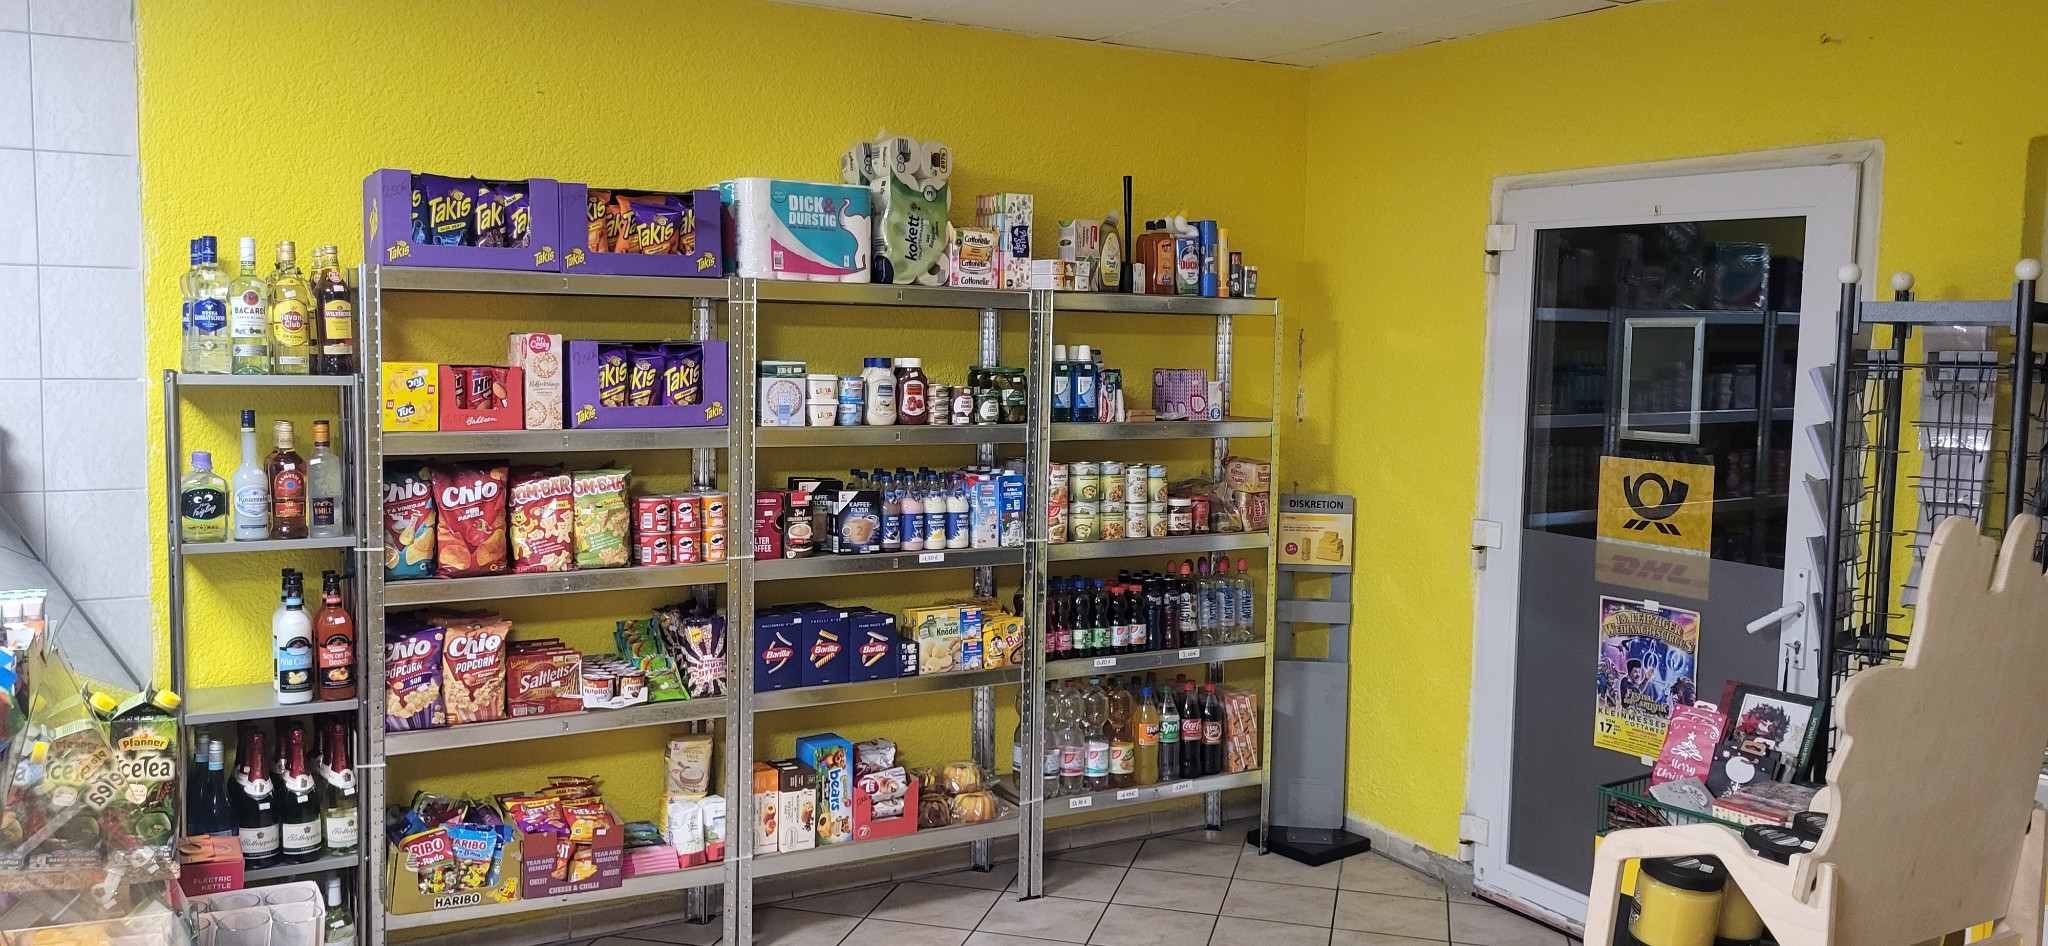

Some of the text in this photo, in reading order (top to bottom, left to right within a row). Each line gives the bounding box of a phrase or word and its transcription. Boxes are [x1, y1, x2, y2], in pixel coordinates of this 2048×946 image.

[429, 197, 472, 231] Takis
[788, 211, 837, 228] DURSTIG
[636, 221, 674, 250] Takis
[905, 214, 920, 261] kokett
[284, 319, 301, 328] Club
[599, 362, 627, 389] akis
[664, 364, 700, 397] Takis
[397, 406, 415, 416] TUC
[442, 480, 498, 507] Chio
[1290, 500, 1344, 509] DISKRETION
[1611, 554, 1692, 585] DHL
[936, 627, 958, 636] Knödel
[1632, 613, 1684, 636] LEIPZIGER
[449, 632, 501, 657] Chio
[1603, 624, 1695, 653] WEIHNACHTSCIRCUS
[815, 645, 838, 654] Barilla
[863, 645, 886, 653] Barilla
[328, 657, 349, 666] Beach
[455, 655, 494, 674] POPCORN
[519, 663, 570, 693] Saltletts
[1598, 708, 1667, 728] KLEINMESSEP
[1625, 720, 1665, 735] COTTAWEG
[1671, 759, 1696, 777] Merry
[830, 769, 842, 811] bears
[406, 838, 444, 856] RIBO
[528, 864, 552, 872] REMOVE
[540, 857, 555, 865] AND
[193, 875, 232, 884] ELECTRIC
[201, 882, 232, 891] KETTLE
[549, 885, 572, 894] CHEESE
[435, 893, 480, 909] HARIBO
